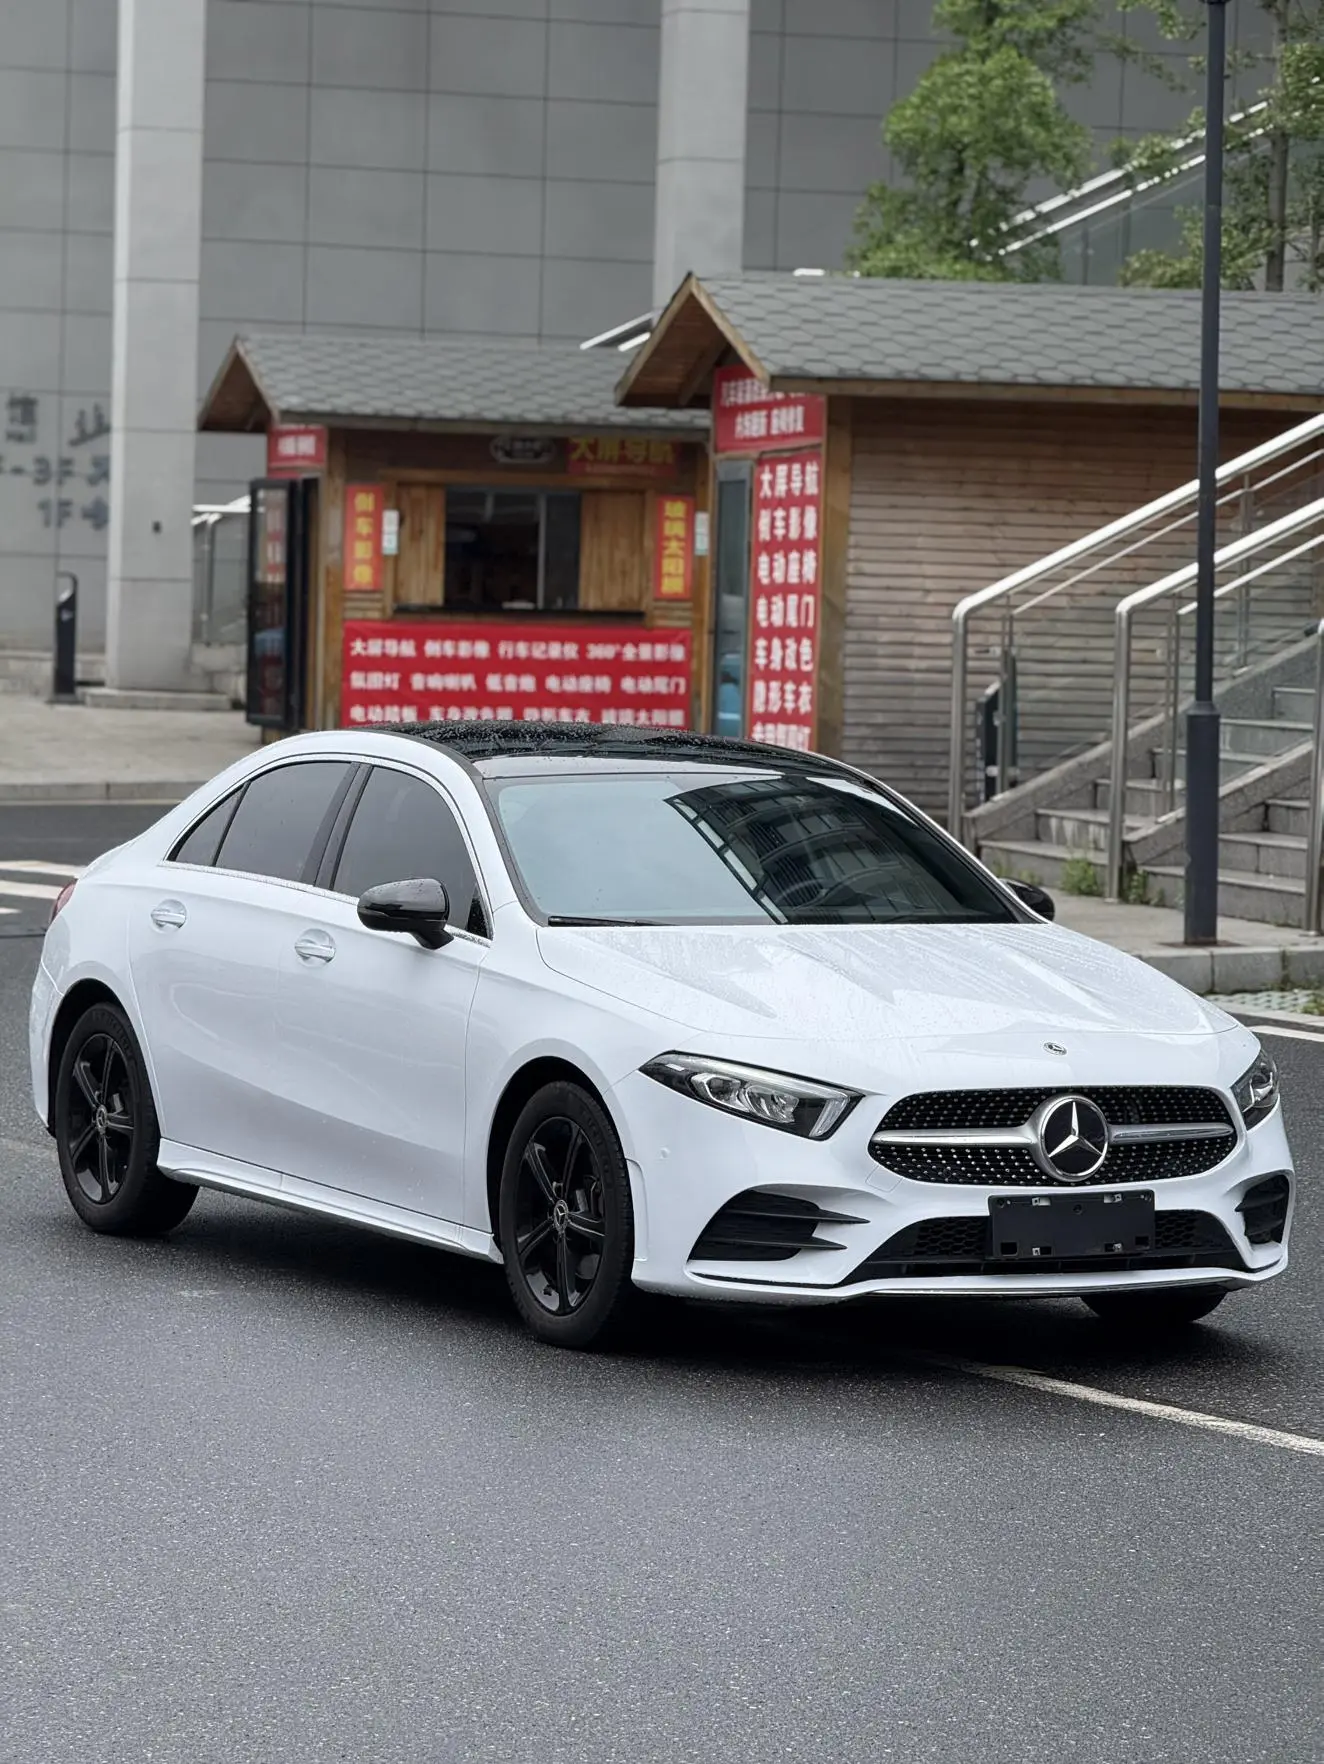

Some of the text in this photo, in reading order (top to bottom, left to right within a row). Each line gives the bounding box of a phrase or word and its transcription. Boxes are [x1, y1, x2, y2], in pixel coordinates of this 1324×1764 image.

[760, 461, 819, 499] 大屏导航
[758, 505, 817, 542] 倒车影像
[757, 548, 816, 585] 电动座椅
[756, 592, 815, 628] 电动尾门
[350, 637, 417, 658] 大屏导航
[754, 636, 813, 672] 车身改色
[752, 679, 812, 716] 隐形车衣
